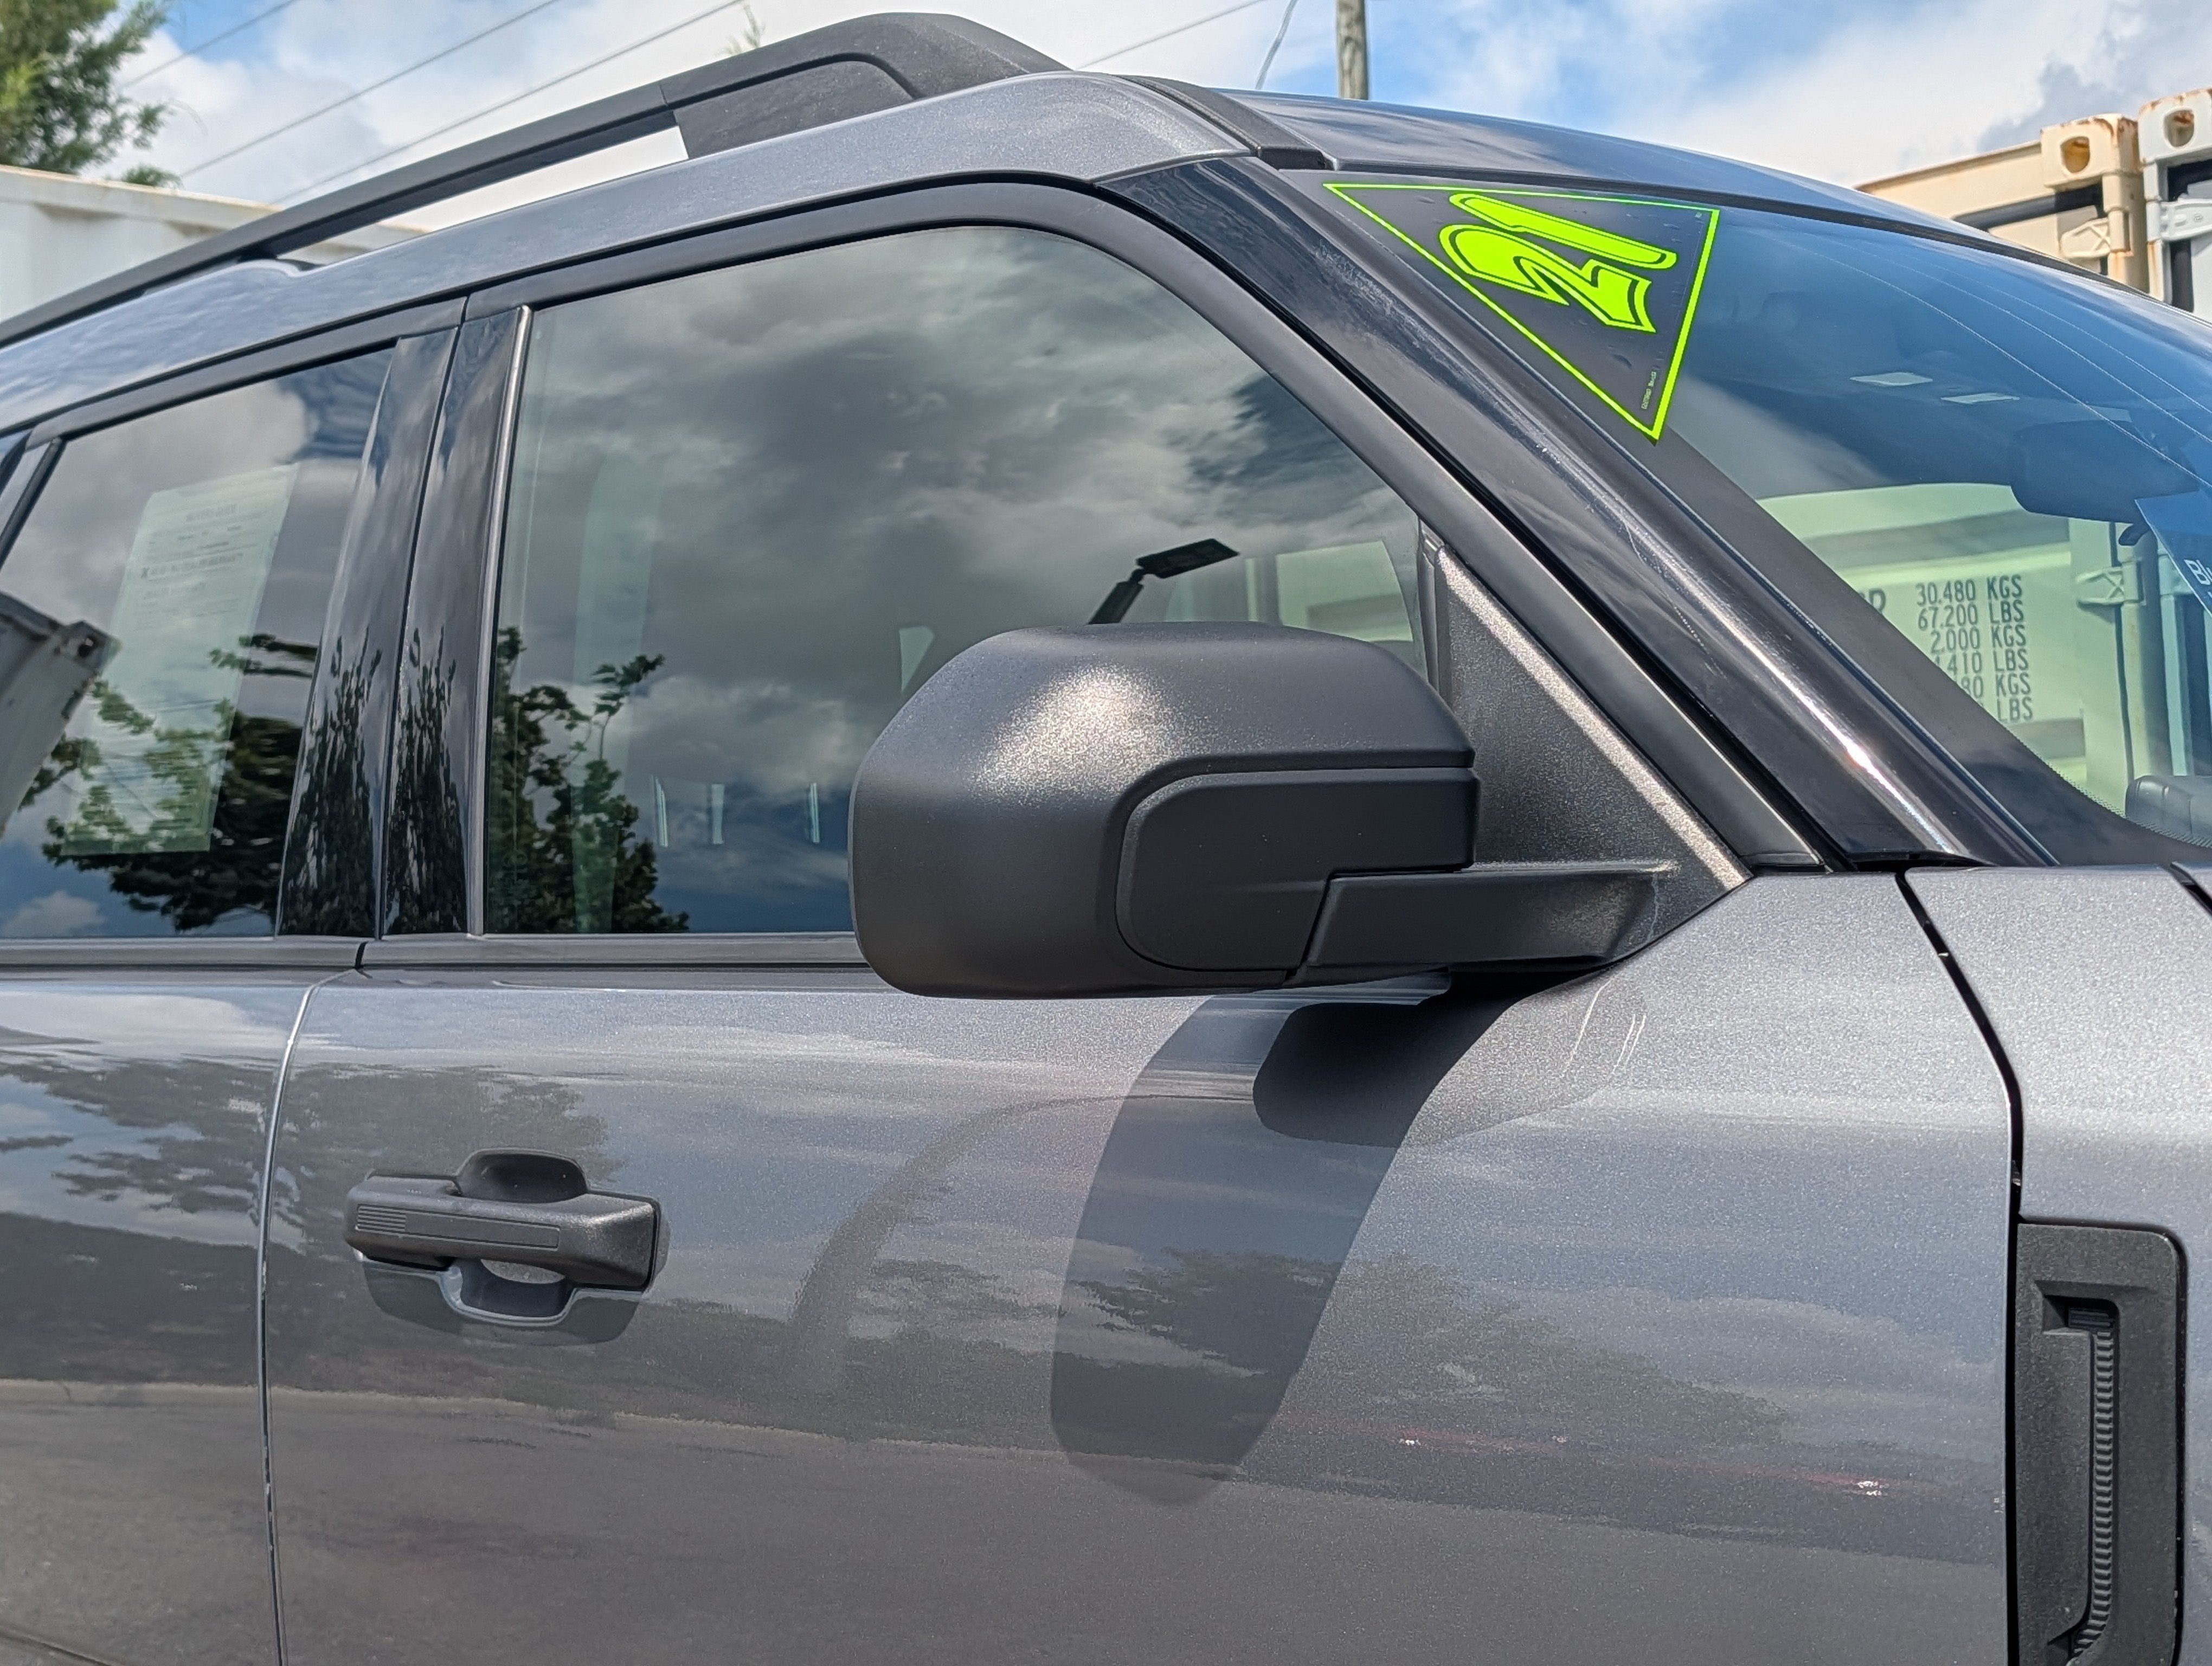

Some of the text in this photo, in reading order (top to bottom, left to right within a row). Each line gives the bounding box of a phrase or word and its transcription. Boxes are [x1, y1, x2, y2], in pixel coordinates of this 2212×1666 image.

[1438, 193, 1677, 333] 21
[1915, 579, 1976, 607] 30.480
[1986, 574, 2023, 600] KGS
[1918, 599, 2024, 631] 67.200 LBS
[1930, 624, 2027, 655] 2.000 KGS
[1993, 649, 2029, 672] LBS
[1996, 672, 2031, 697] KGS
[1997, 696, 2033, 723] LBS
